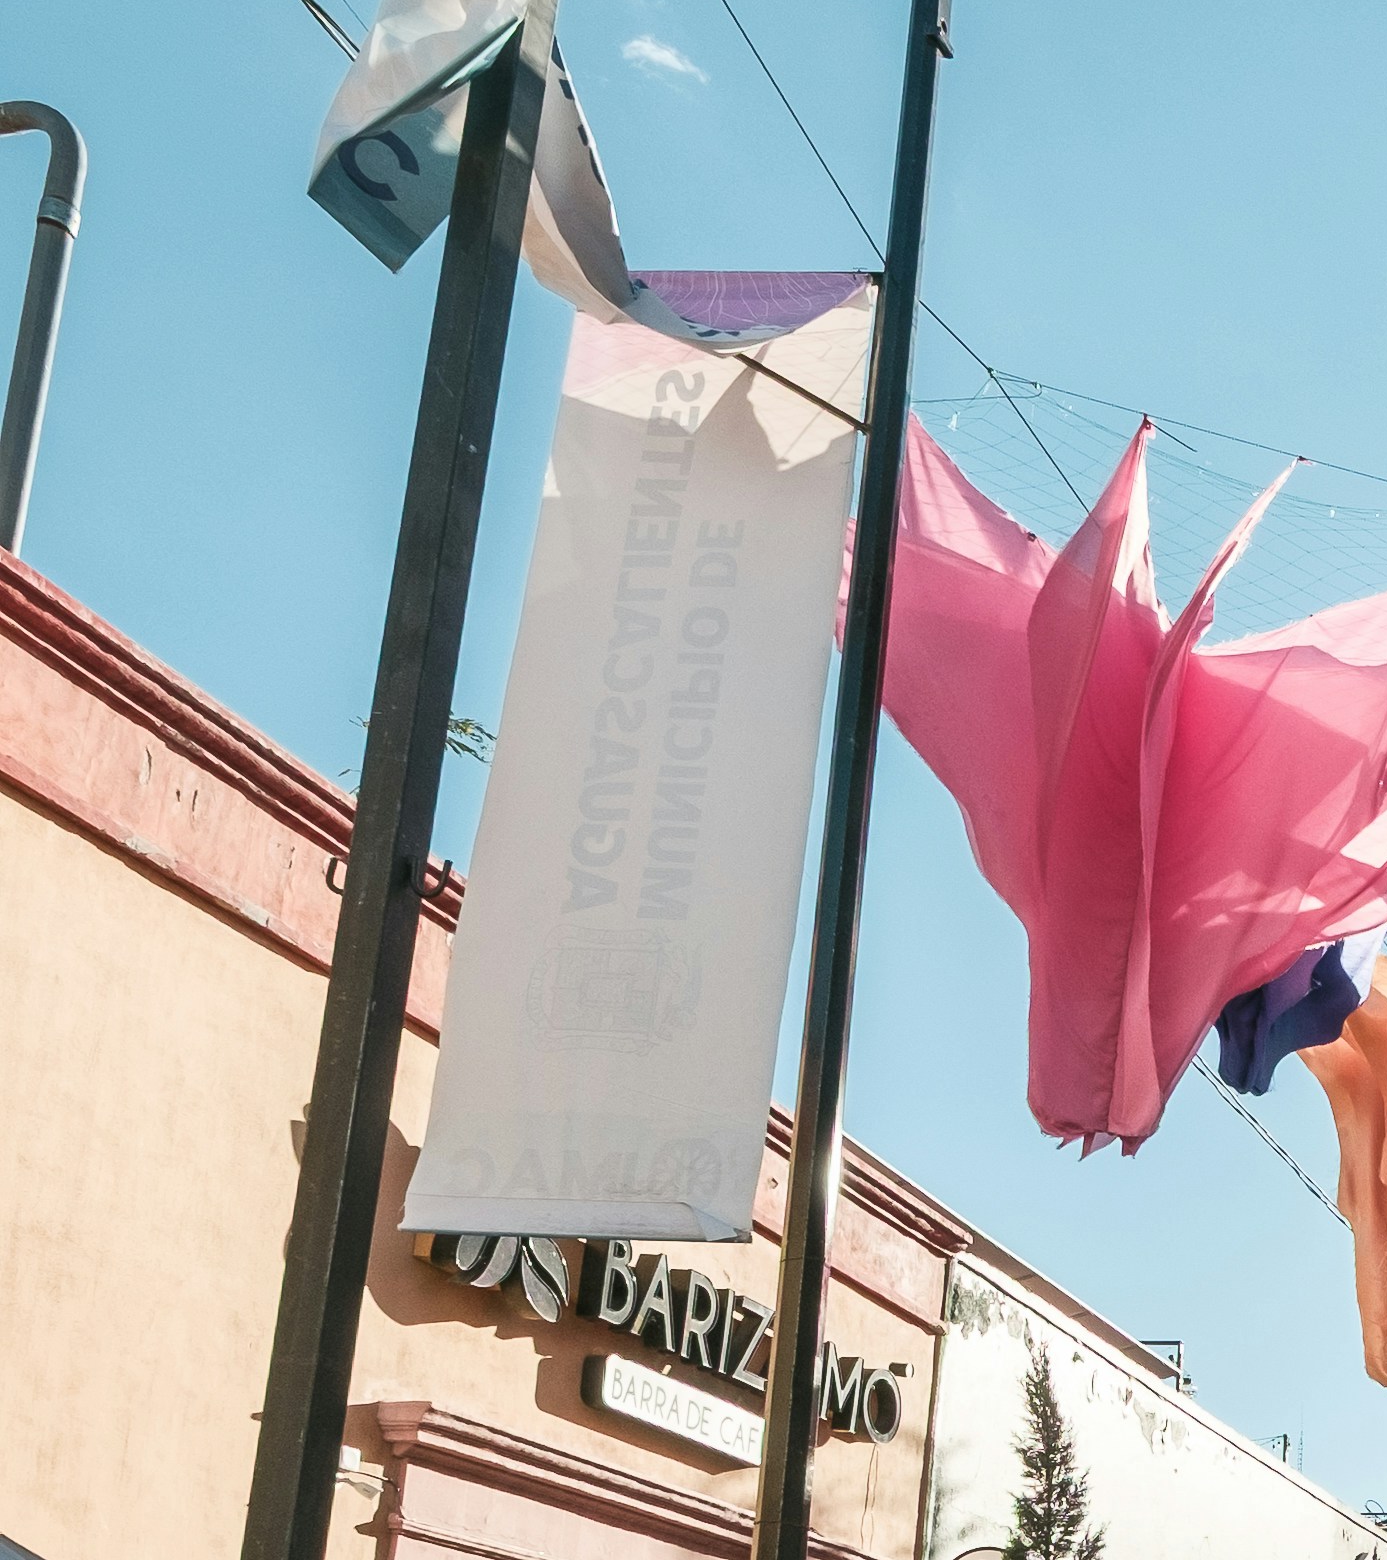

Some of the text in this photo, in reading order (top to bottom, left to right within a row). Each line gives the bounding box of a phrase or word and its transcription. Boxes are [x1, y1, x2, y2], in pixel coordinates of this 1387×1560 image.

[610, 1367, 761, 1455] BARRA DE CAF
